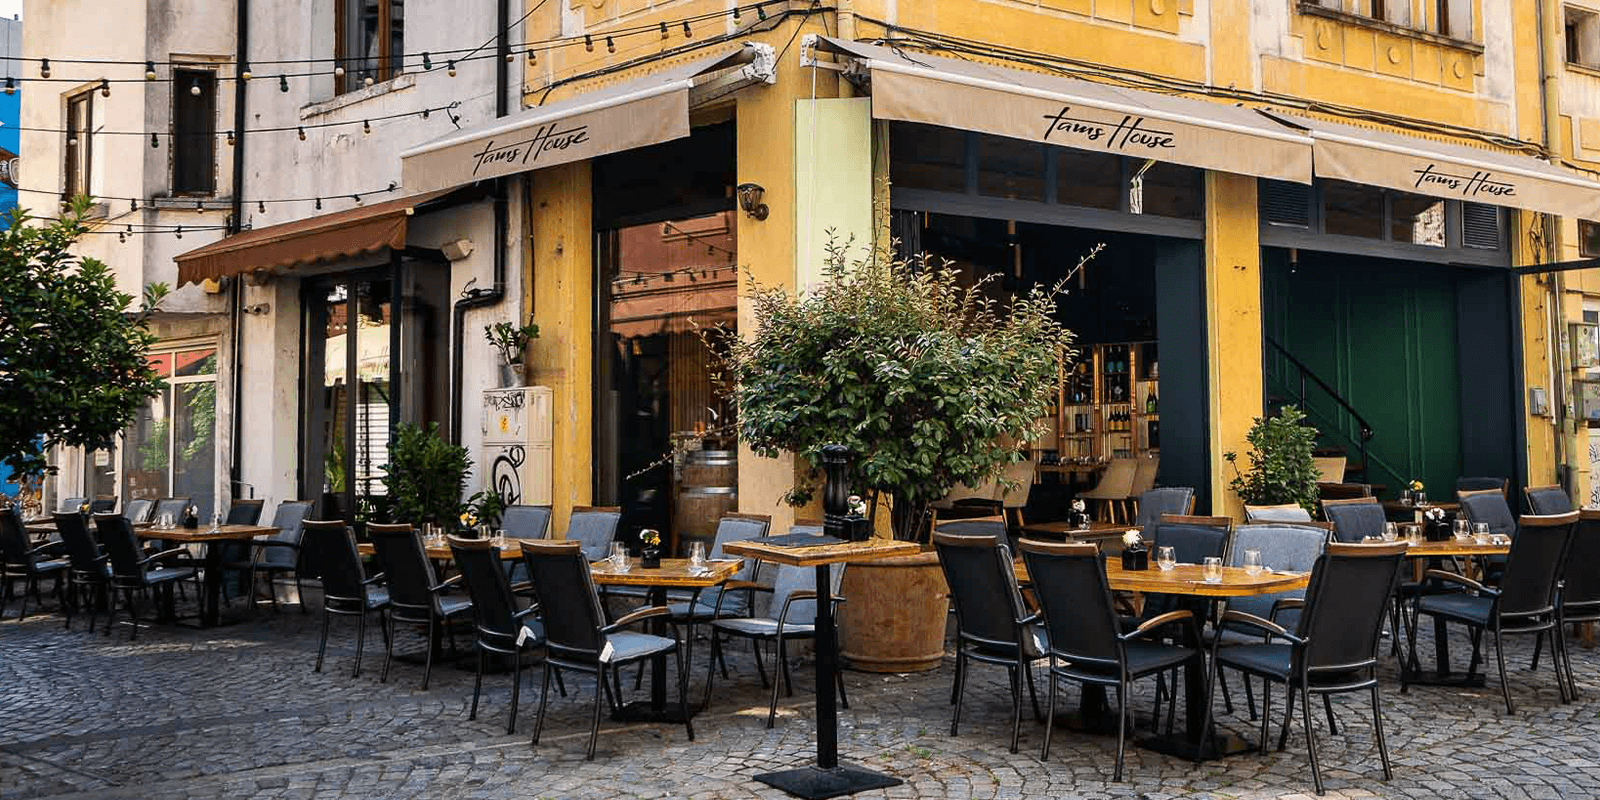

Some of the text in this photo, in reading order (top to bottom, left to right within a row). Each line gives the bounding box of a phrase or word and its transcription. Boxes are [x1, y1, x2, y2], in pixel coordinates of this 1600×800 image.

[523, 123, 589, 164] House
[1107, 116, 1175, 148] House
[1463, 171, 1516, 196] House
